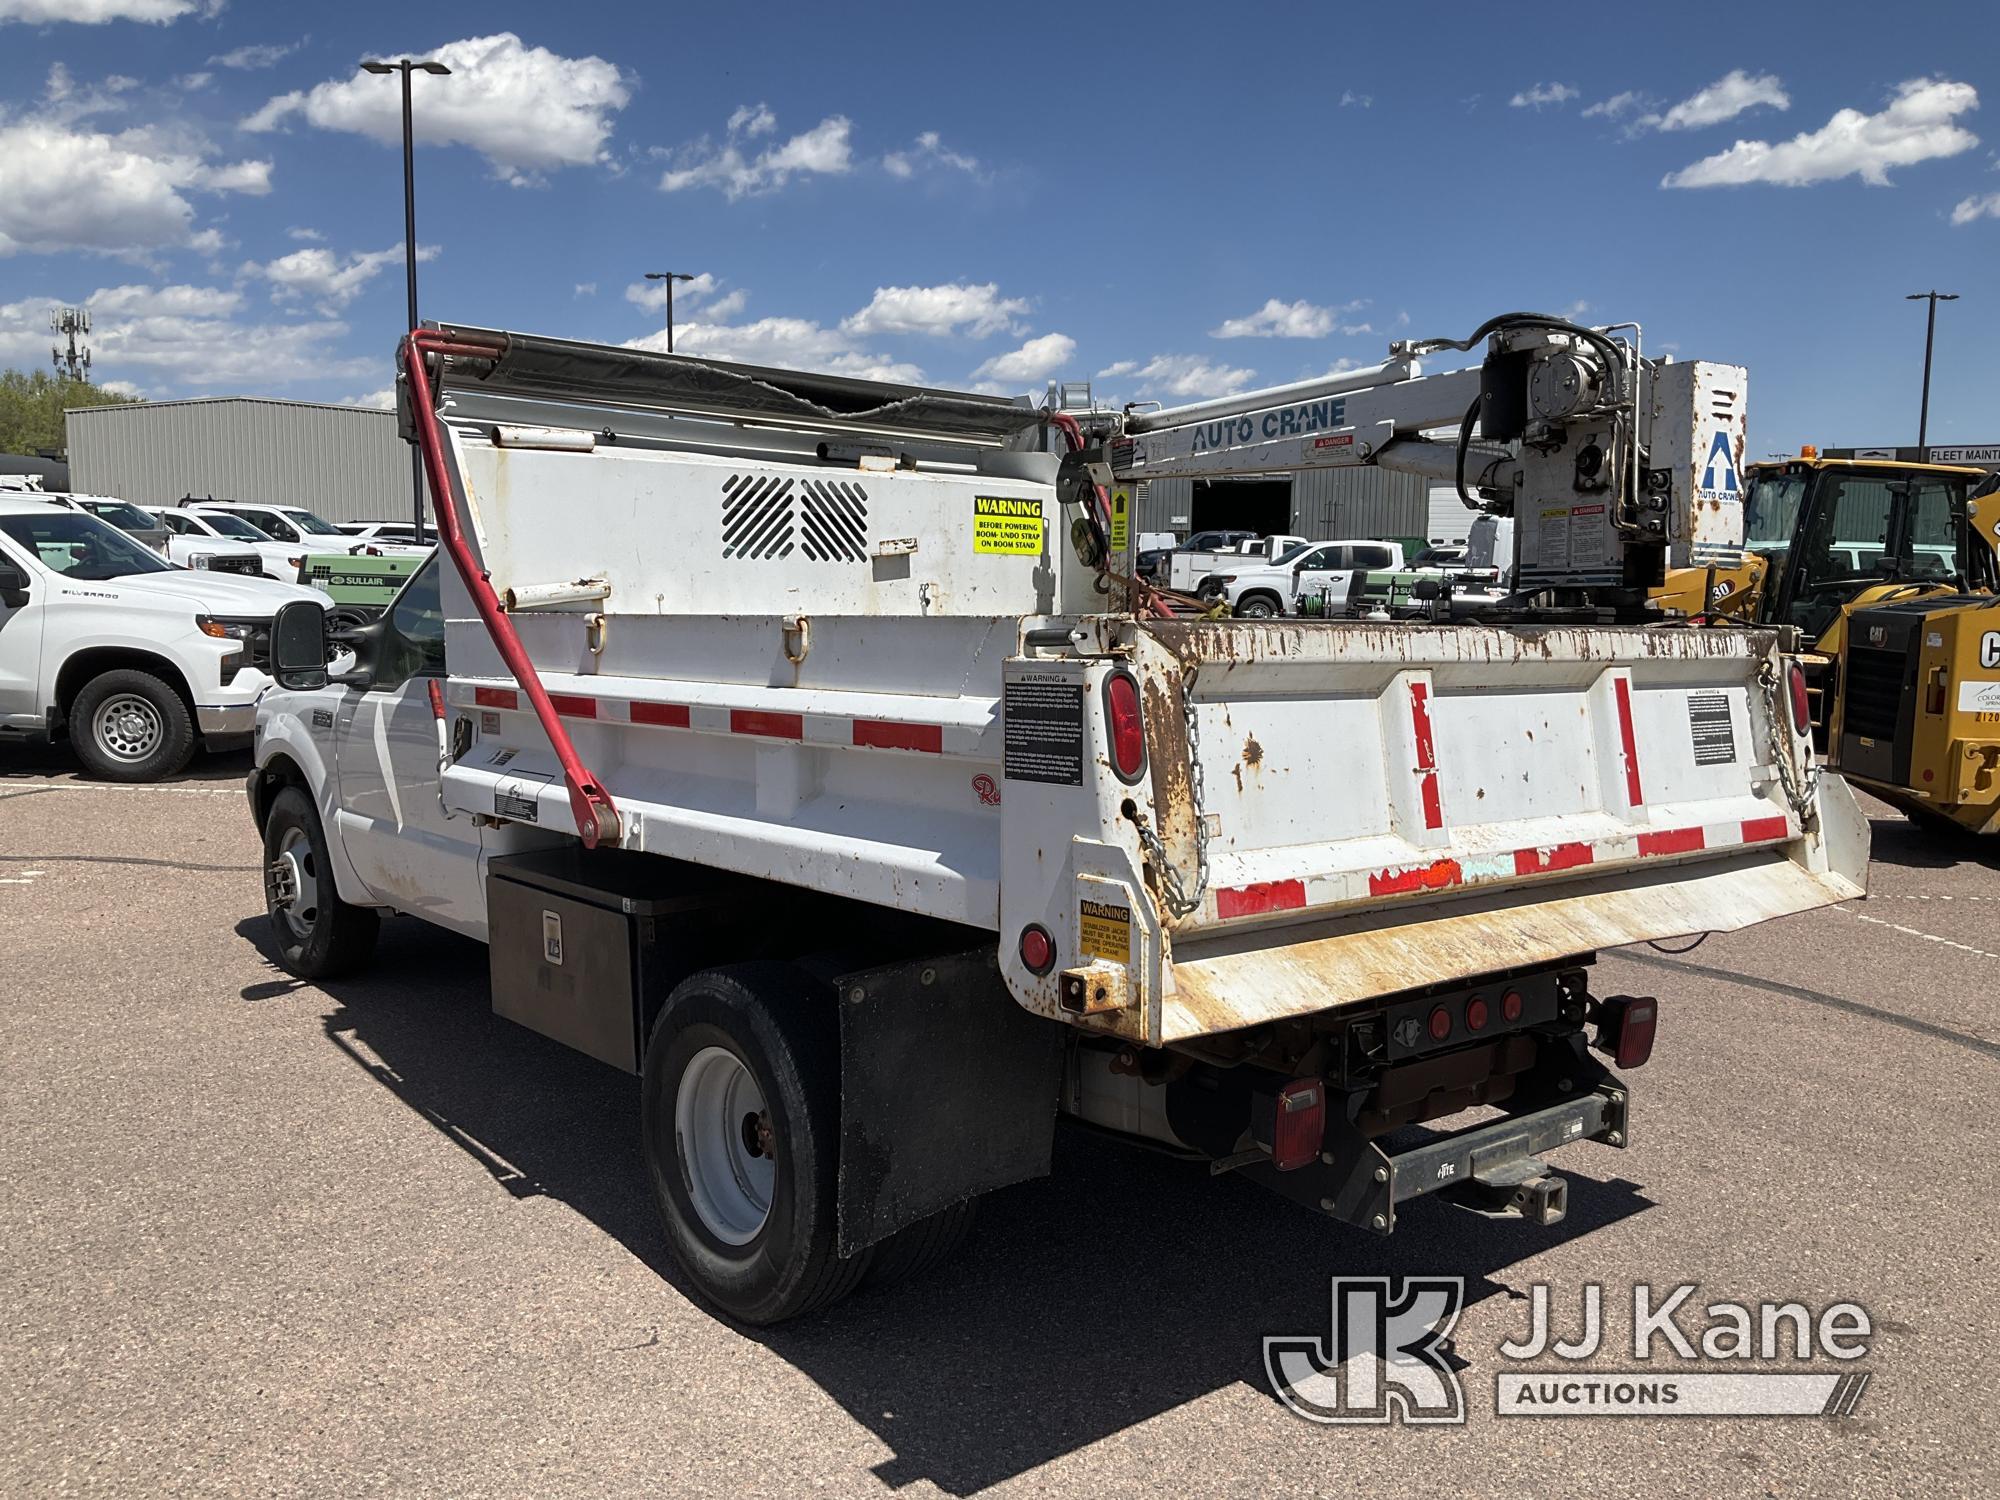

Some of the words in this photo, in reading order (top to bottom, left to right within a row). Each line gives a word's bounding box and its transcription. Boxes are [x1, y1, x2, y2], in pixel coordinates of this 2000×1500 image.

[1192, 416, 1253, 451] AUTO
[1262, 399, 1346, 438] CRANE
[1324, 436, 1350, 445] DANGER
[1931, 450, 1963, 461] FLEET
[977, 498, 1041, 516] WARNING
[1580, 505, 1603, 513] DANGER
[979, 521, 1003, 529] BEFORE
[1005, 522, 1038, 531] POWERING
[976, 530, 998, 538] BOOM-
[1000, 531, 1019, 539] UNDO
[1021, 532, 1040, 540] STRAP
[981, 539, 992, 547] ON
[994, 540, 1014, 548] BOOM
[1015, 541, 1036, 549] STAND
[346, 576, 383, 585] SULLAIR
[61, 589, 119, 599] SILVERADO
[1713, 582, 1730, 600] 30
[1026, 674, 1060, 682] WARNING
[1083, 901, 1128, 921] WARNING
[1082, 929, 1096, 937] MUST
[1098, 931, 1105, 939] BE
[1112, 934, 1127, 943] PLACE
